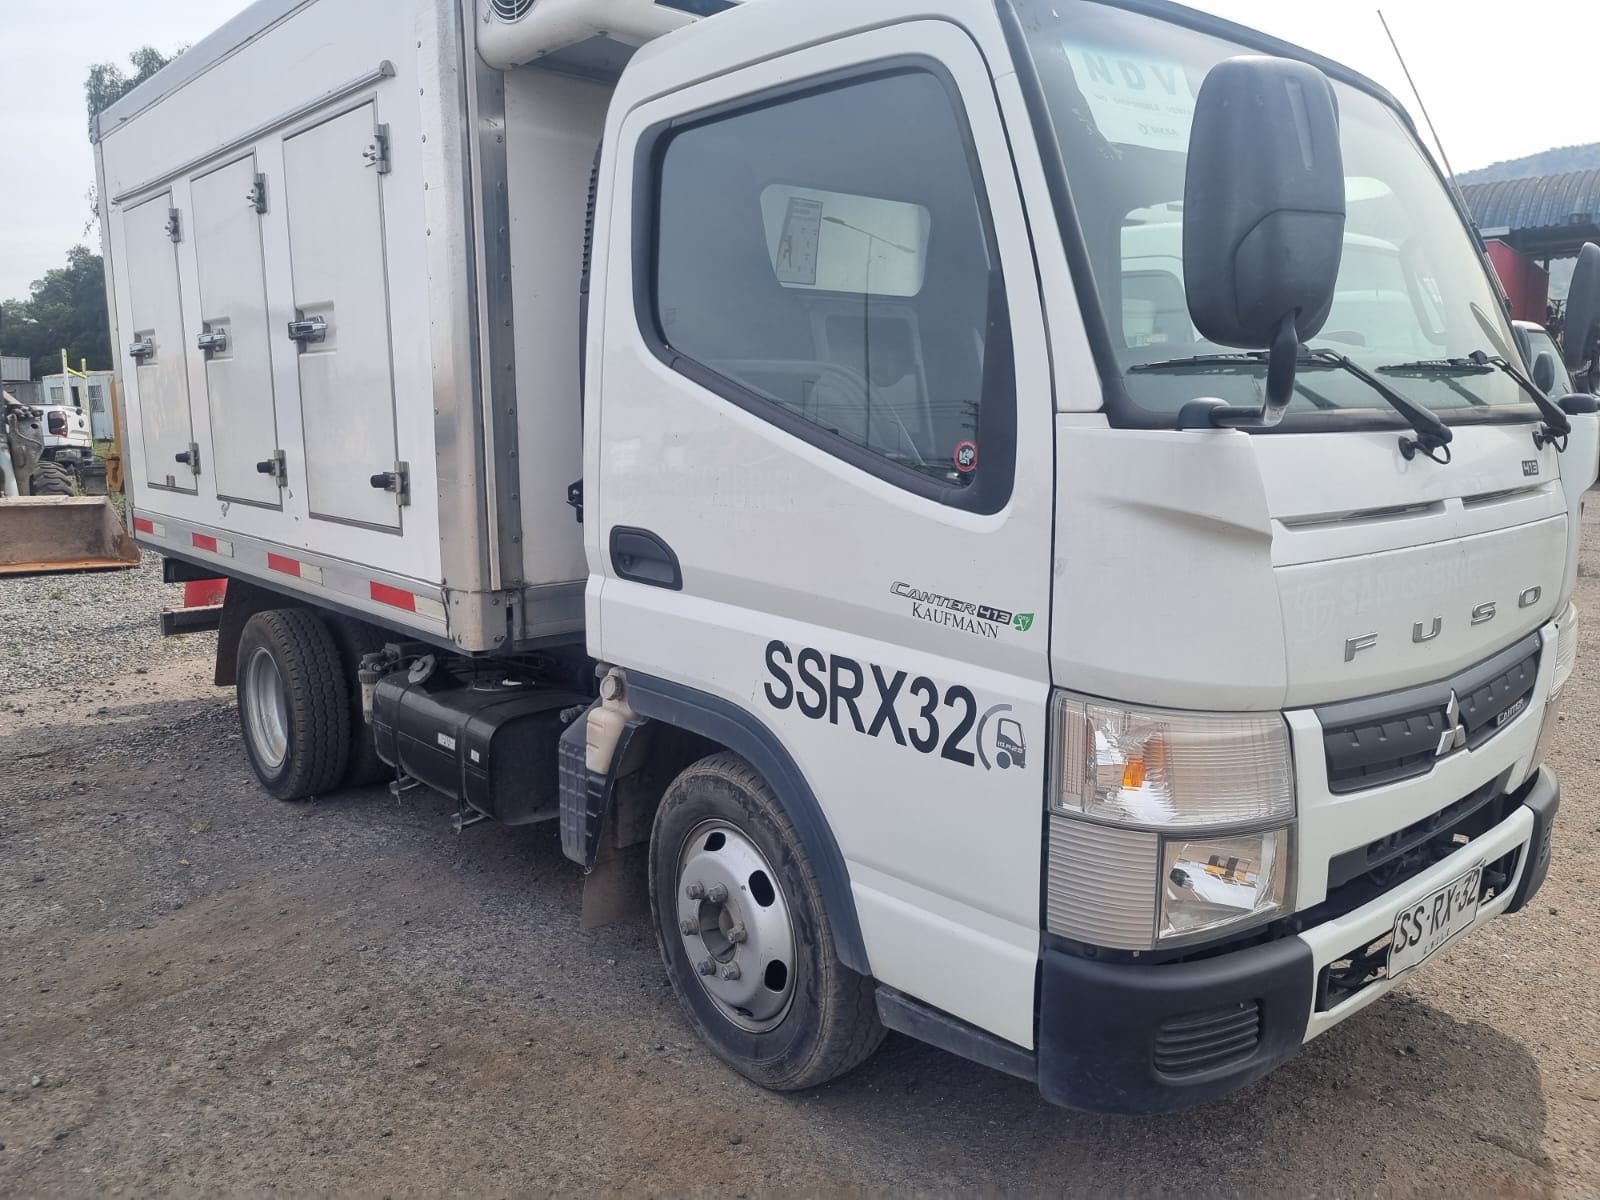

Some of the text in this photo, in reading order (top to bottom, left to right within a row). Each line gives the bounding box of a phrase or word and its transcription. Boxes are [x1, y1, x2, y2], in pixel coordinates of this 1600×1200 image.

[889, 581, 977, 615] CANTER
[979, 606, 1010, 624] 413
[912, 601, 999, 639] KAUFMANN
[1344, 585, 1541, 662] FUSO
[764, 640, 977, 767] SSRX32
